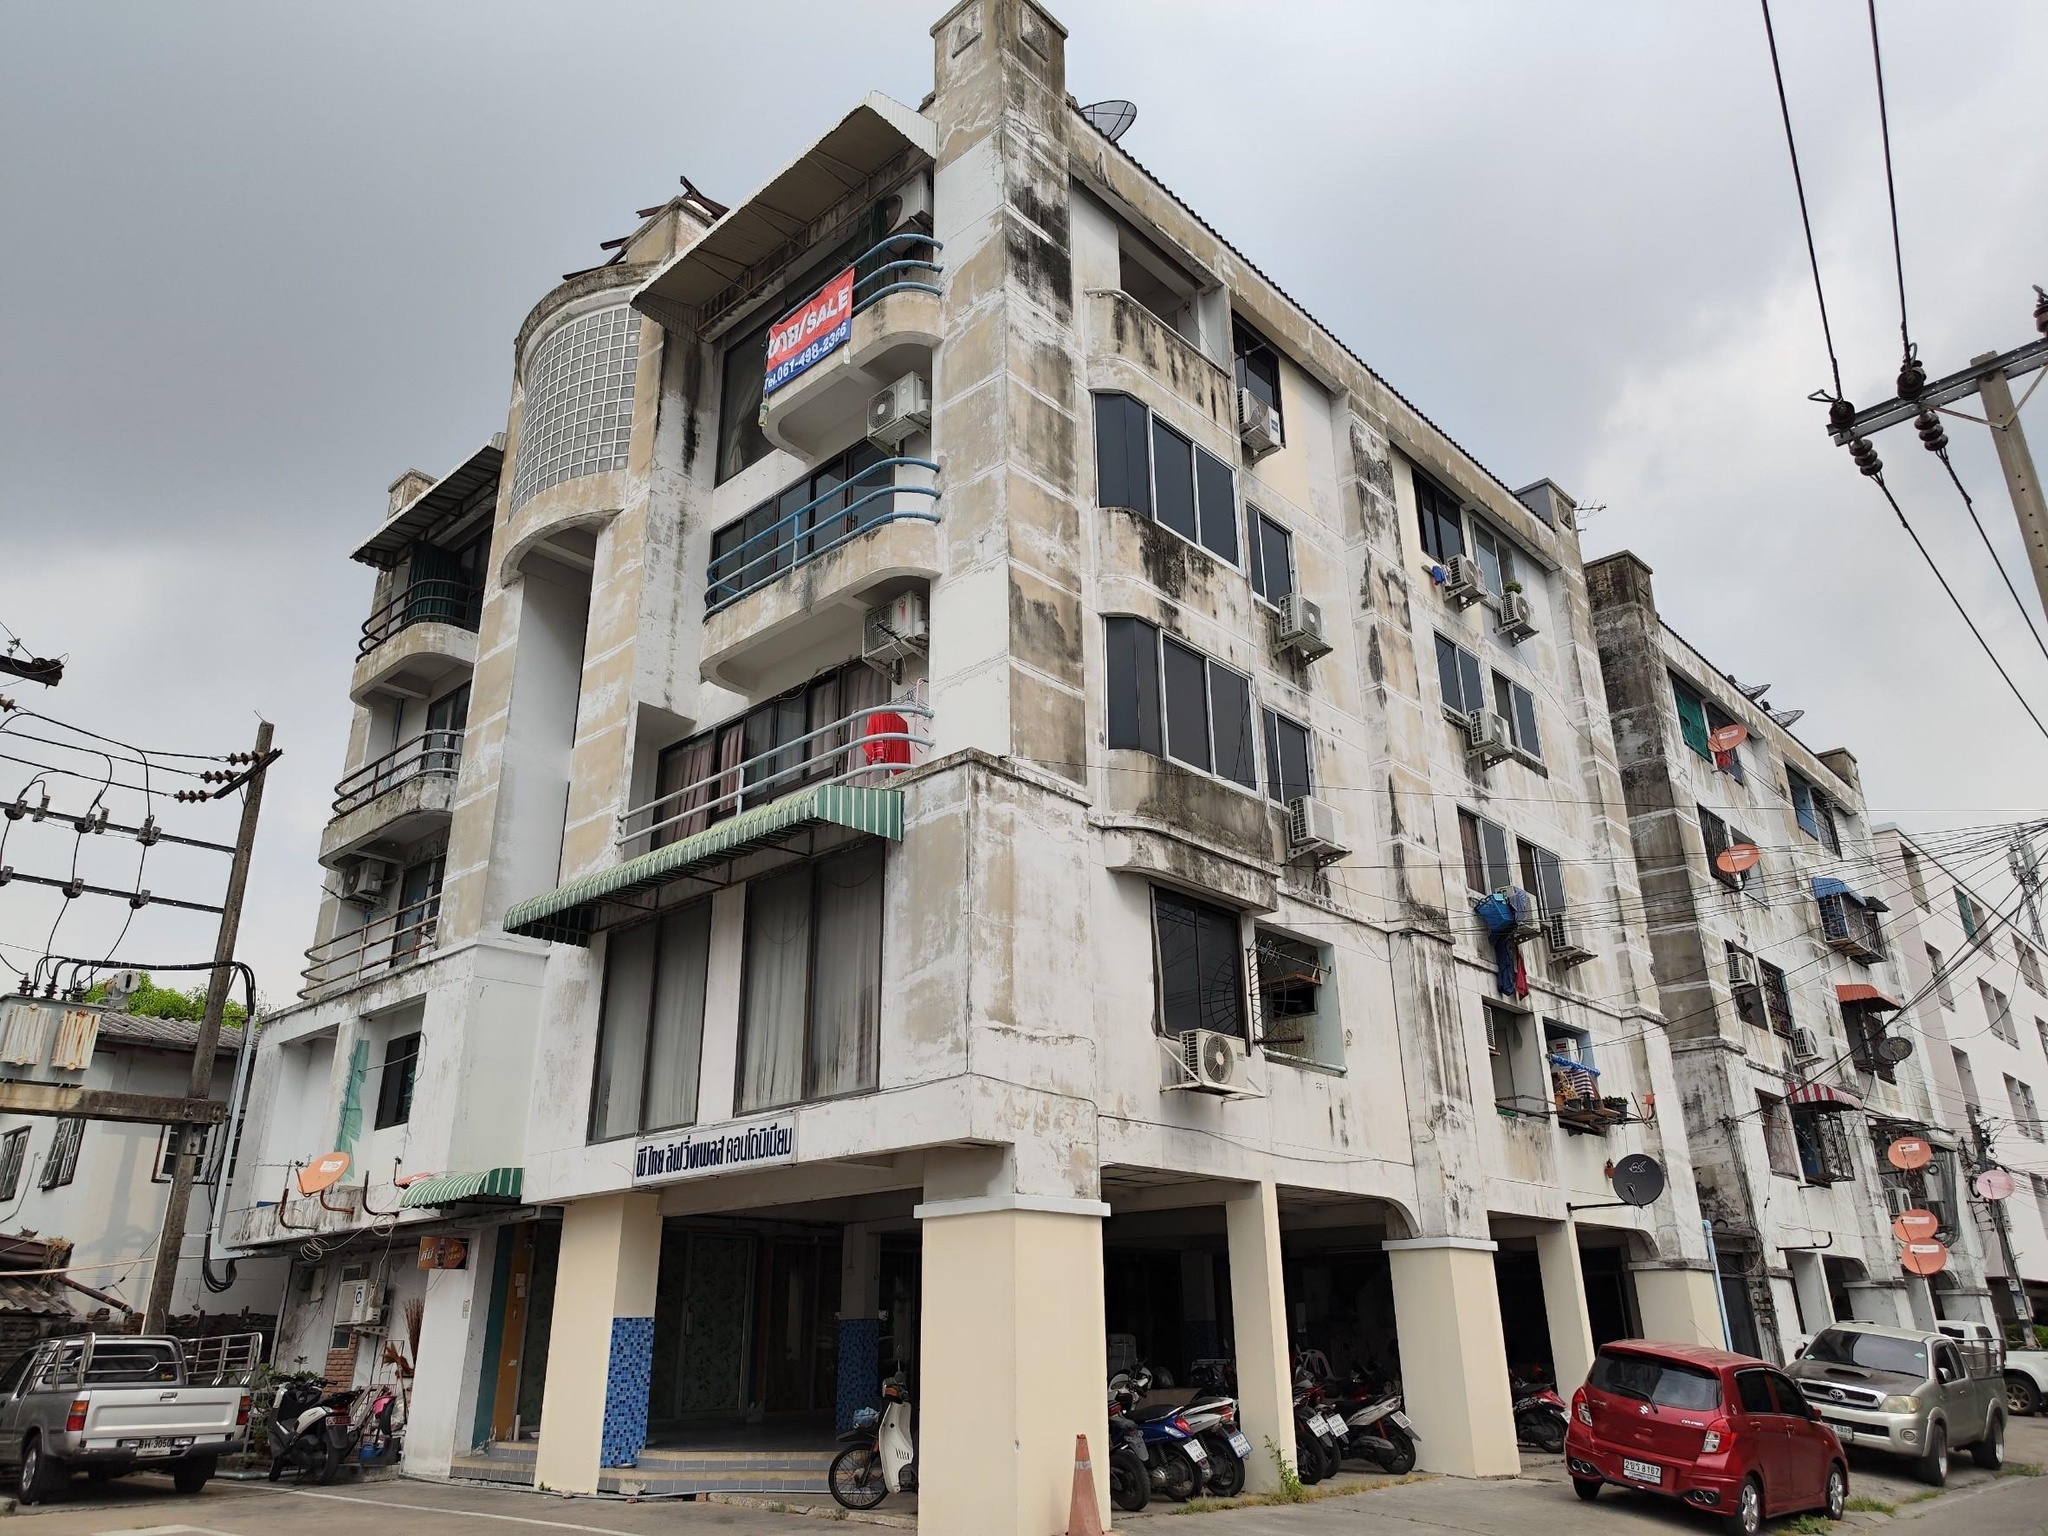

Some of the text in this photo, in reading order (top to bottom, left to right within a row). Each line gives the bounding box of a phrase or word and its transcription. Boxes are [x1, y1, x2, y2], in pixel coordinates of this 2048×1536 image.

[725, 1122, 793, 1164] คอนโดมิเนียม
[1641, 1464, 1660, 1475] 8167
